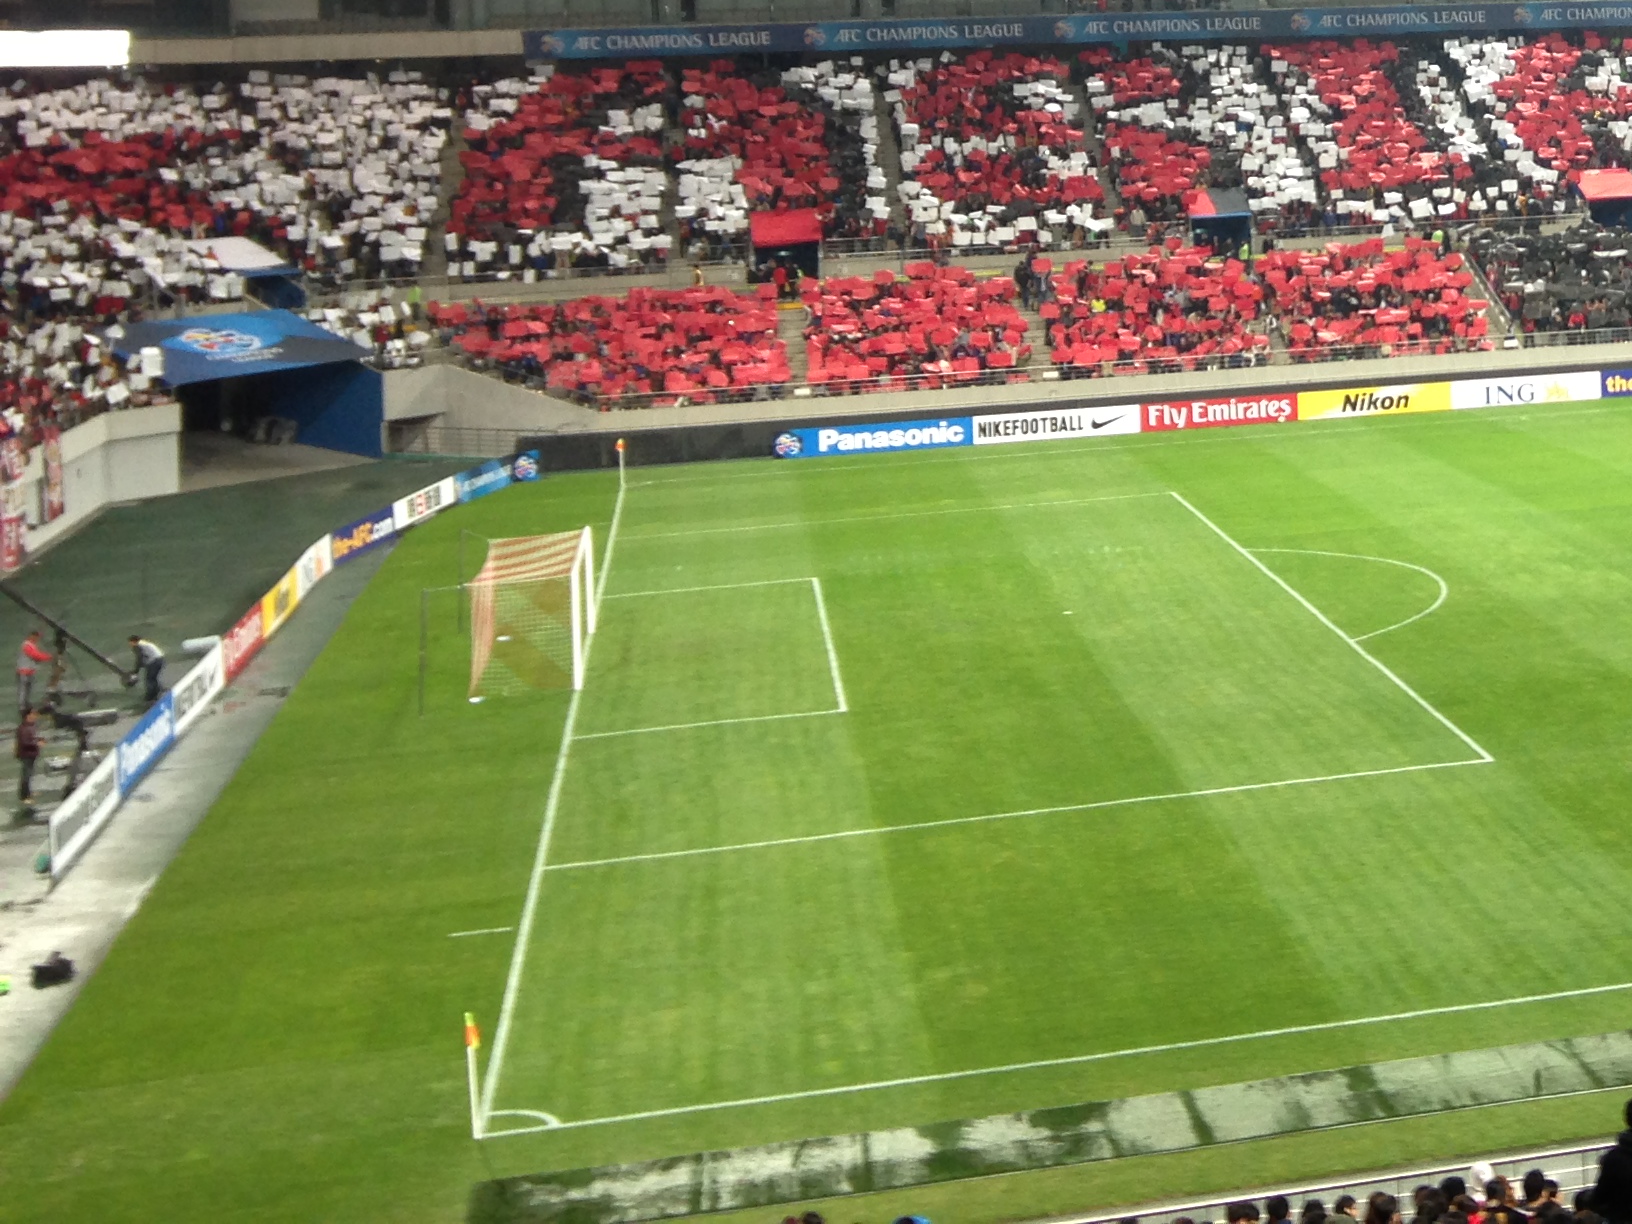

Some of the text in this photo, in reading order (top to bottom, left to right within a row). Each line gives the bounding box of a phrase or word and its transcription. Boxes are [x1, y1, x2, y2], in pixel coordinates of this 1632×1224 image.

[1319, 9, 1487, 28] AFC CHAMPIONS LEAGUE
[1539, 7, 1563, 21] AFC
[834, 22, 1024, 43] AFC CHAMPIONS LEAGUE
[1083, 17, 1262, 35] AFC CHAMPIONS LEAGUE
[572, 30, 771, 51] AFC CHAMPIONS LEAGUE
[1341, 392, 1409, 413] Nikon
[1485, 383, 1536, 405] ING
[1149, 397, 1292, 428] Fly Emirates
[818, 421, 965, 453] Panasonic
[977, 415, 1083, 438] NIKEFOOTBALL
